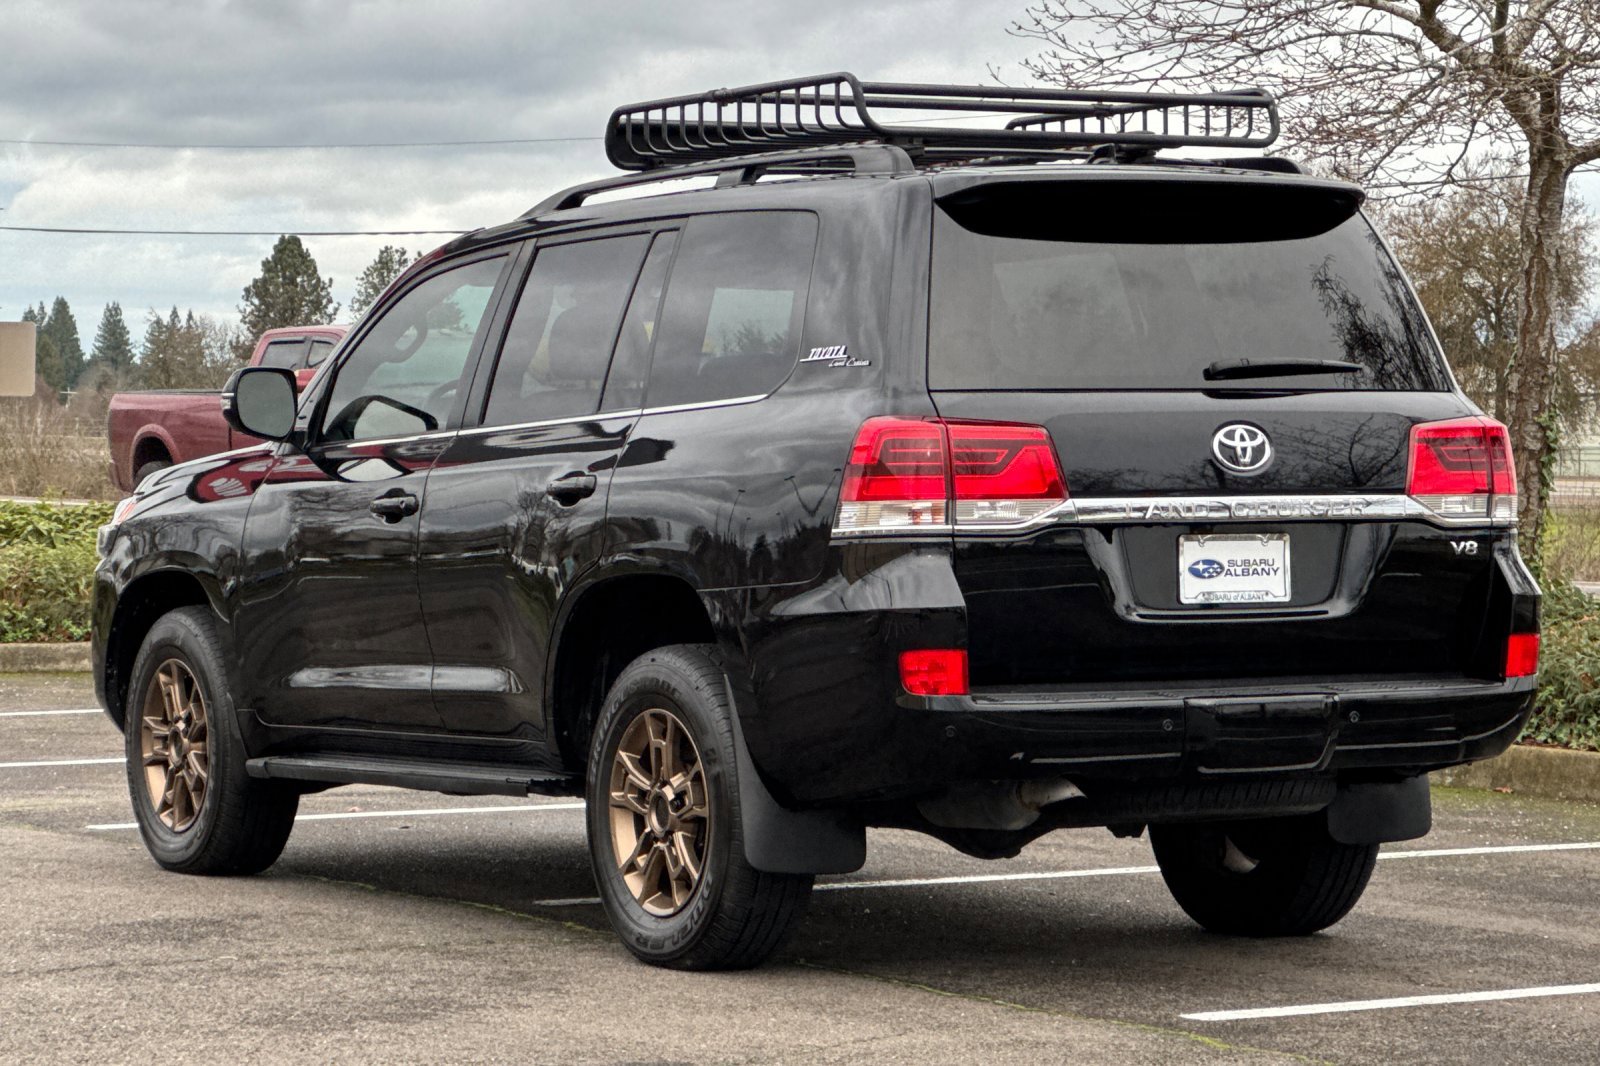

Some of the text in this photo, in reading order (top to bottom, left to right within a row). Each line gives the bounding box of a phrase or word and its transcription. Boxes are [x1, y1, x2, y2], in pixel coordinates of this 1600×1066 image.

[808, 345, 847, 359] TOYOTA
[1126, 500, 1209, 519] LAND
[1450, 541, 1478, 555] V8
[1227, 558, 1275, 567] SUBARU
[1224, 567, 1279, 577] ALBANY
[1241, 591, 1264, 601] ALBANY
